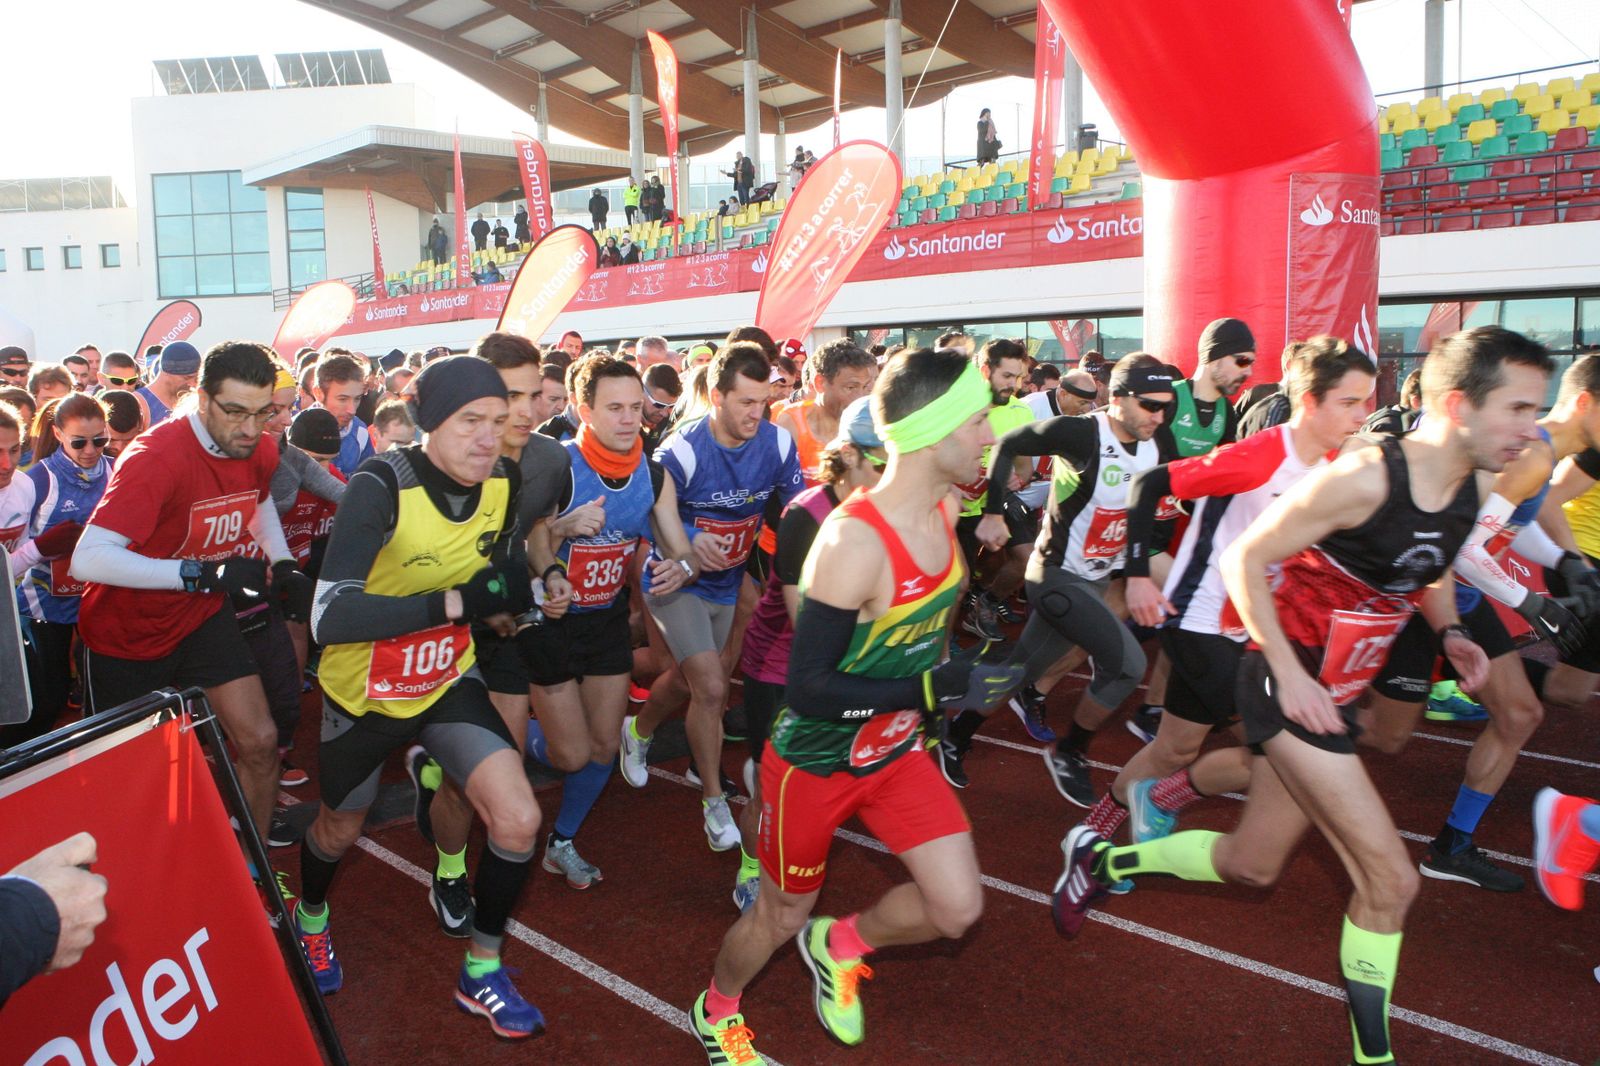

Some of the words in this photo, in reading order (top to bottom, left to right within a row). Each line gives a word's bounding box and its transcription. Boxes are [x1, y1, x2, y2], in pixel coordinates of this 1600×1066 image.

[818, 167, 853, 216] correr
[908, 229, 1006, 258] Santander
[520, 244, 589, 319] Santander
[373, 303, 408, 320] Santander
[430, 293, 469, 311] Santander
[712, 488, 750, 501] CLUB
[202, 510, 243, 549] 709
[1101, 518, 1128, 542] 46
[583, 556, 625, 589] 335
[401, 635, 455, 677] 106
[843, 708, 875, 716] GORE
